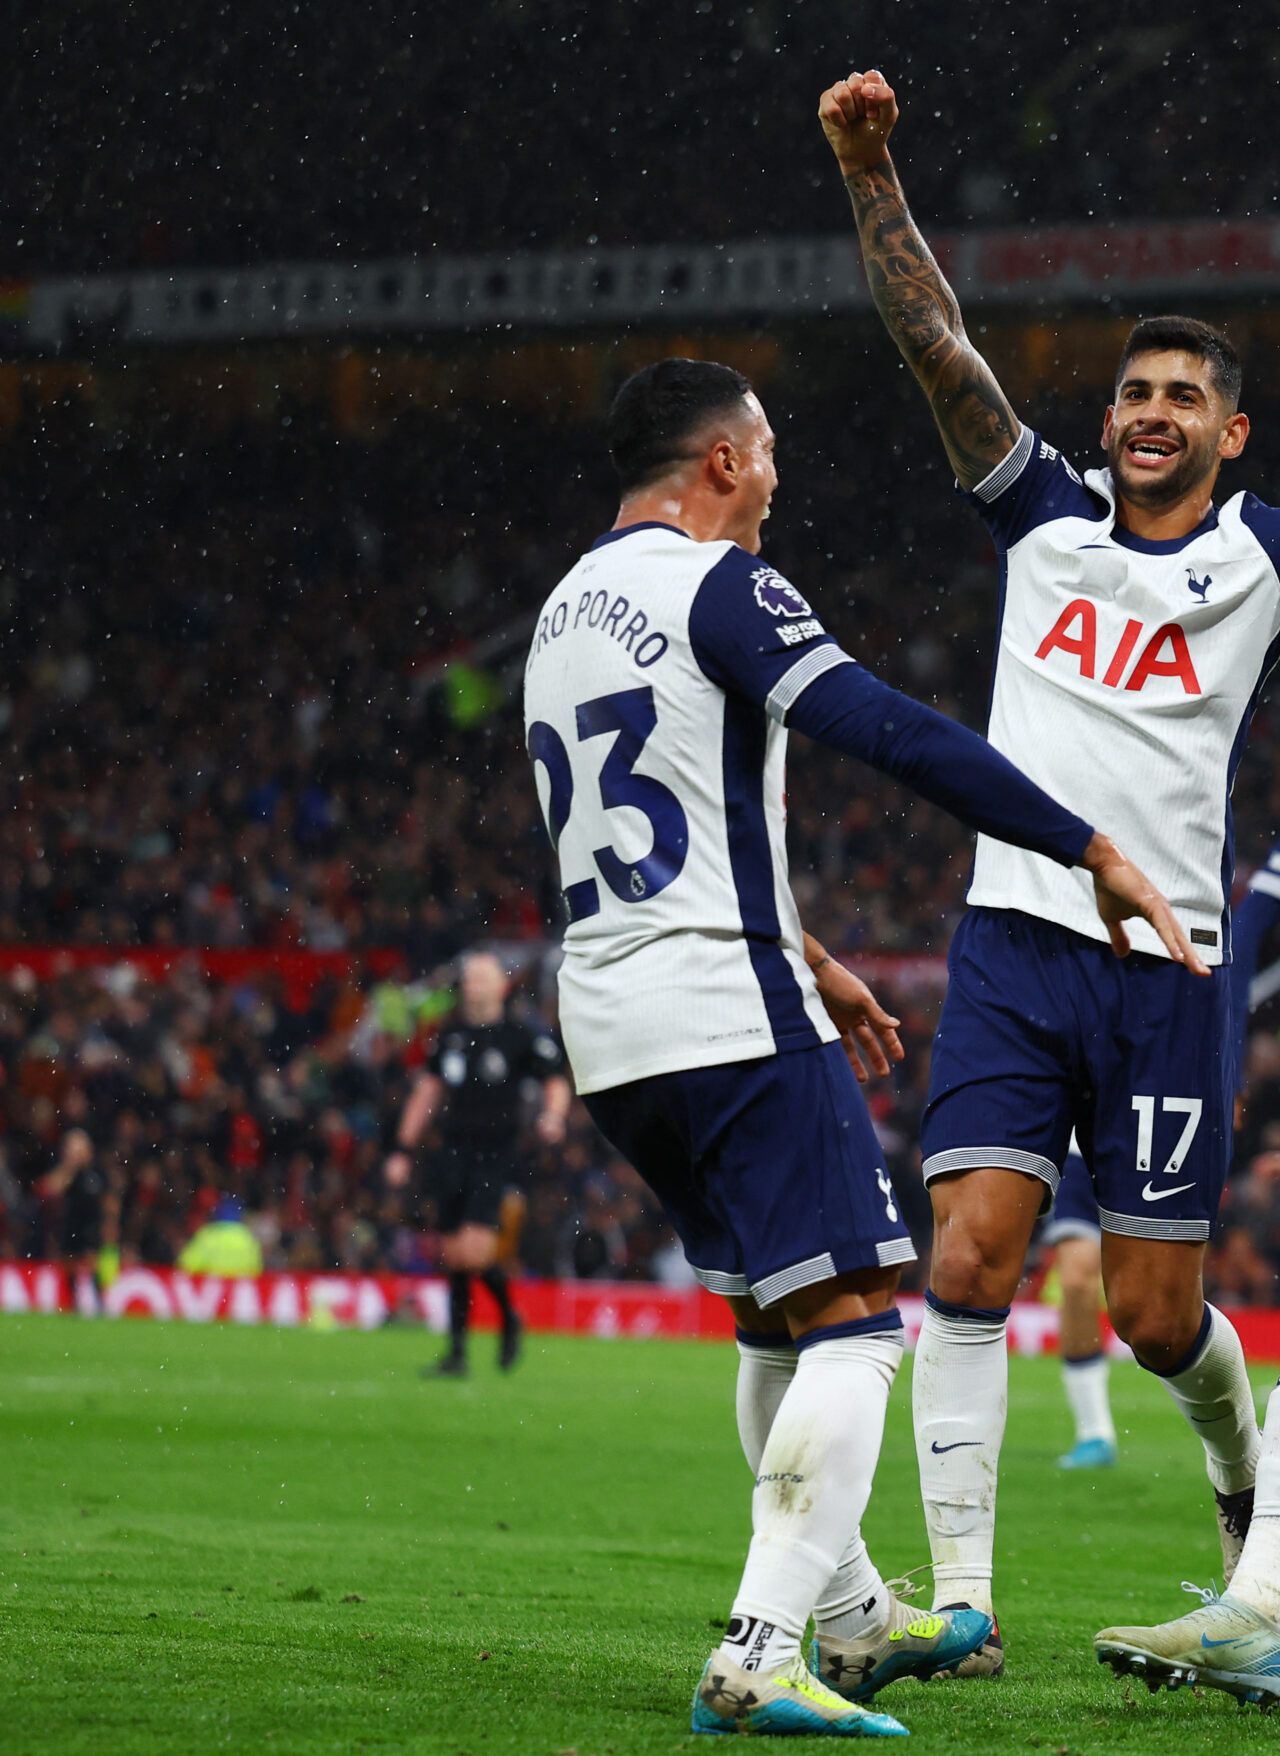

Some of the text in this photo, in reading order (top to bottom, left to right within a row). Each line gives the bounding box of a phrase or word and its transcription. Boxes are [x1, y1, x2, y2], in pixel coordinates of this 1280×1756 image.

[574, 589, 669, 668] PORRO
[1034, 599, 1201, 695] AIA
[528, 686, 689, 922] 23
[1132, 1096, 1203, 1173] 17
[756, 1472, 804, 1487] purs
